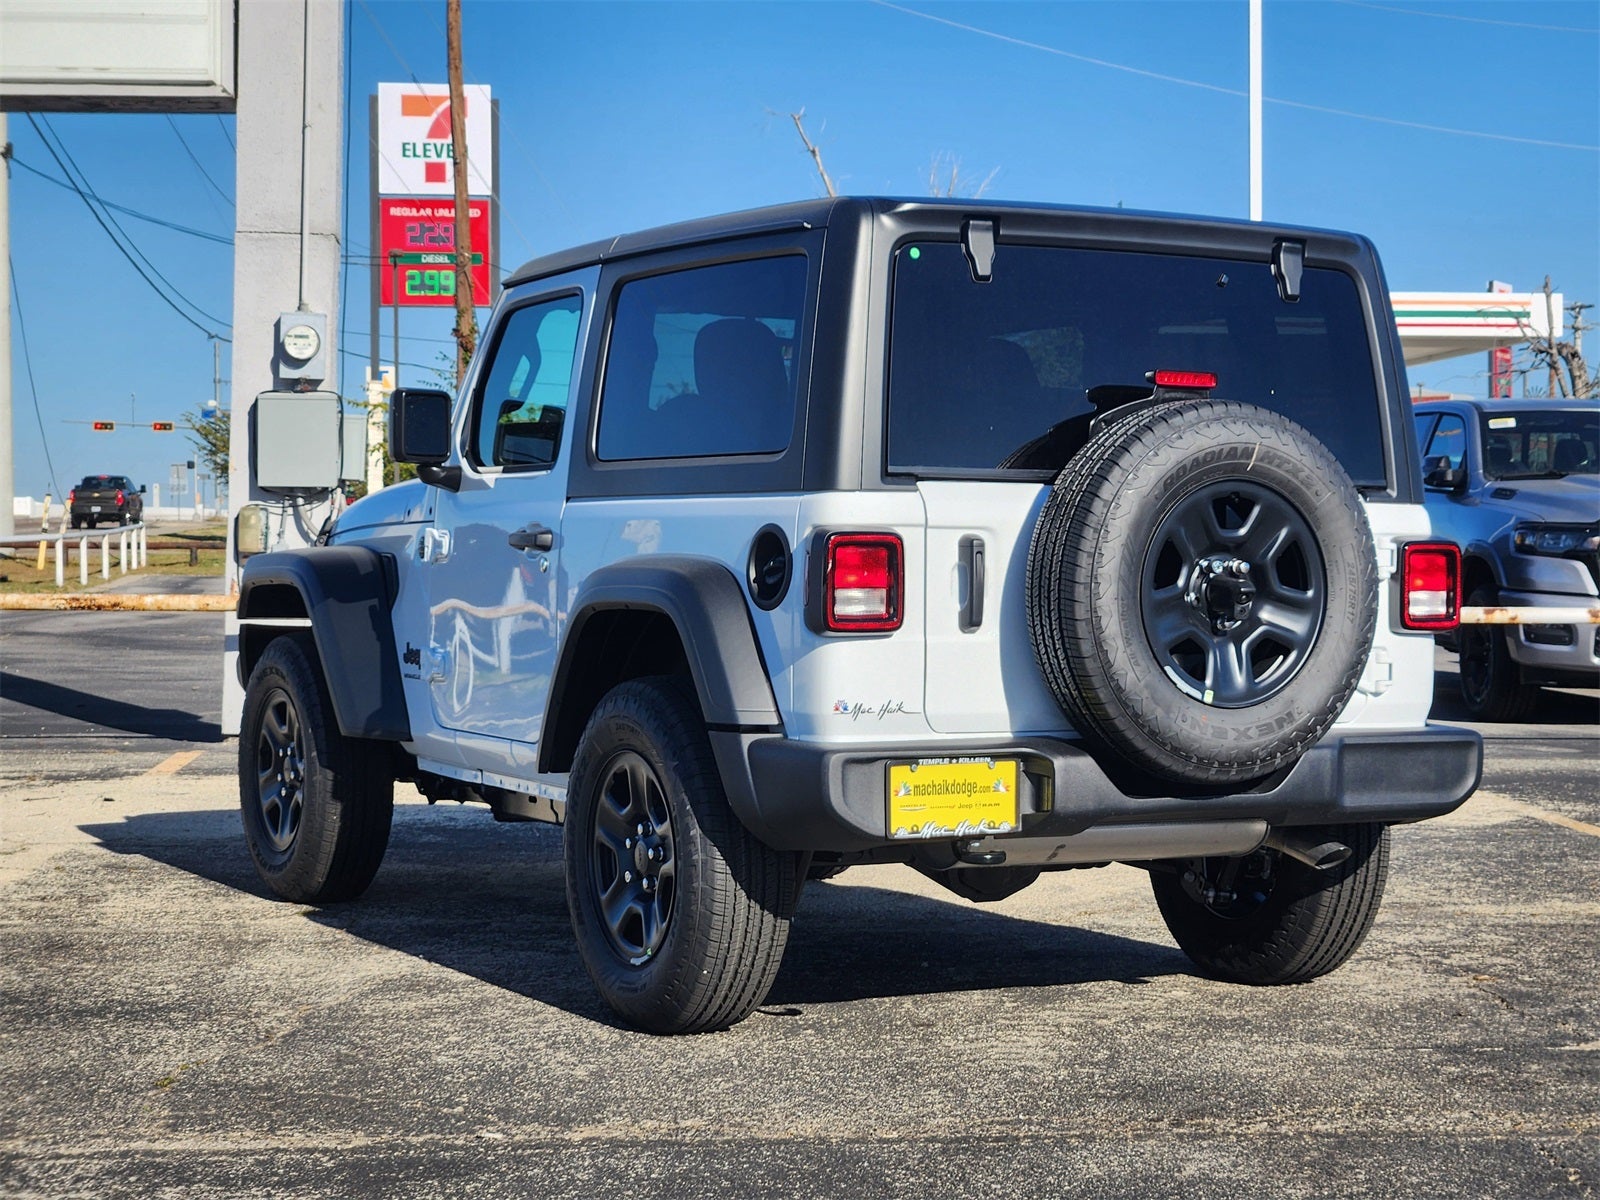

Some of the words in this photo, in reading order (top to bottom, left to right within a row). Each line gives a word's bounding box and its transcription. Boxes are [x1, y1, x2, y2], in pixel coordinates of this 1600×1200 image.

[402, 142, 464, 159] ELEVE
[389, 206, 433, 216] REGULAR
[434, 207, 481, 218] UNLEED
[406, 222, 454, 247] 2.29
[421, 254, 450, 264] DIESEL
[405, 269, 455, 296] 2.99
[849, 703, 875, 721] Mac
[877, 699, 914, 720] Haik
[918, 758, 950, 766] TEMPLE
[912, 779, 991, 798] machaikdodge.com
[920, 820, 951, 840] Mac
[953, 818, 990, 838] Haik
